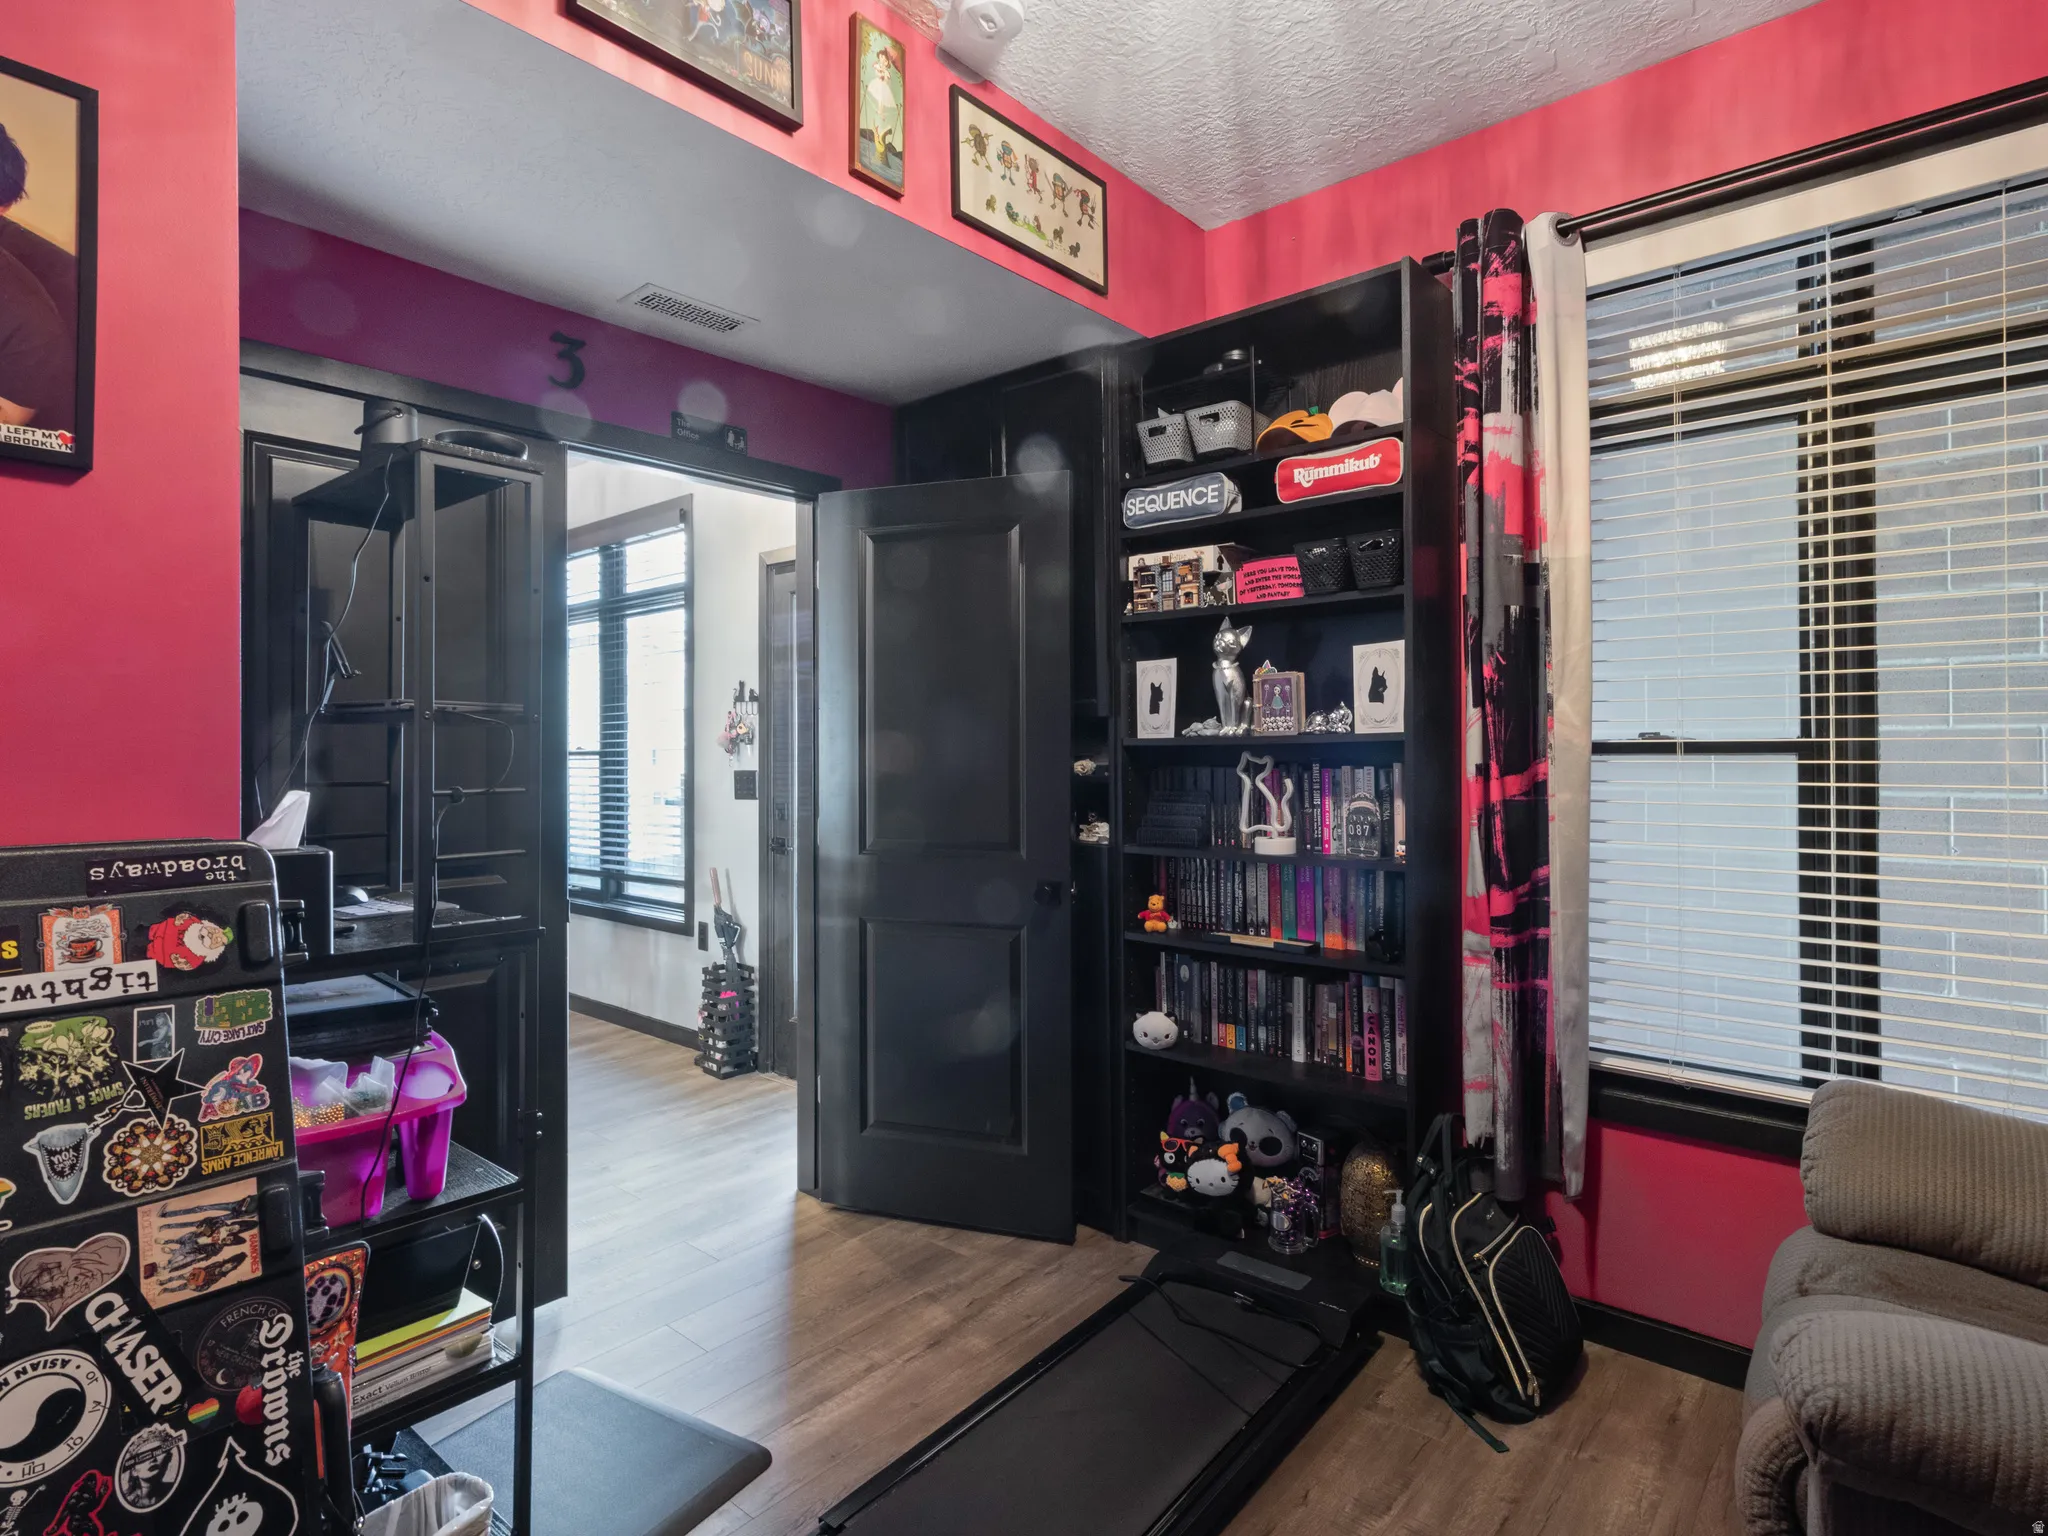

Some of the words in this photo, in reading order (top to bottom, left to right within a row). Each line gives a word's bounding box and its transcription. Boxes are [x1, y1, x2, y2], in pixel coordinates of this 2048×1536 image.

[548, 330, 587, 390] 3
[675, 416, 691, 428] The
[3, 435, 73, 452] BROOKLYN
[7, 426, 37, 437] LEFT
[41, 431, 60, 440] MY
[1126, 484, 1219, 517] SEQUENCE
[1312, 763, 1320, 782] SNAKES
[1312, 790, 1321, 805] SUITS
[1348, 824, 1370, 837] 087
[90, 855, 246, 881] broadways
[205, 870, 236, 882] the
[0, 967, 157, 1005] tightw
[199, 1030, 221, 1043] CITY
[222, 1028, 245, 1041] LAKE
[245, 1022, 264, 1036] SALT
[1367, 1015, 1377, 1067] CANON
[75, 1095, 86, 1110] &
[88, 1082, 125, 1105] SPACE
[24, 1098, 71, 1120] FADERS
[50, 1148, 78, 1165] YOU
[233, 1140, 284, 1167] LAWRENCE
[201, 1154, 231, 1175] ARMS
[249, 1233, 260, 1274] RAMONES
[220, 1304, 268, 1328] FRENCH
[14, 1358, 73, 1380] ASIAN
[284, 1350, 305, 1378] the
[352, 1385, 384, 1406] Exact
